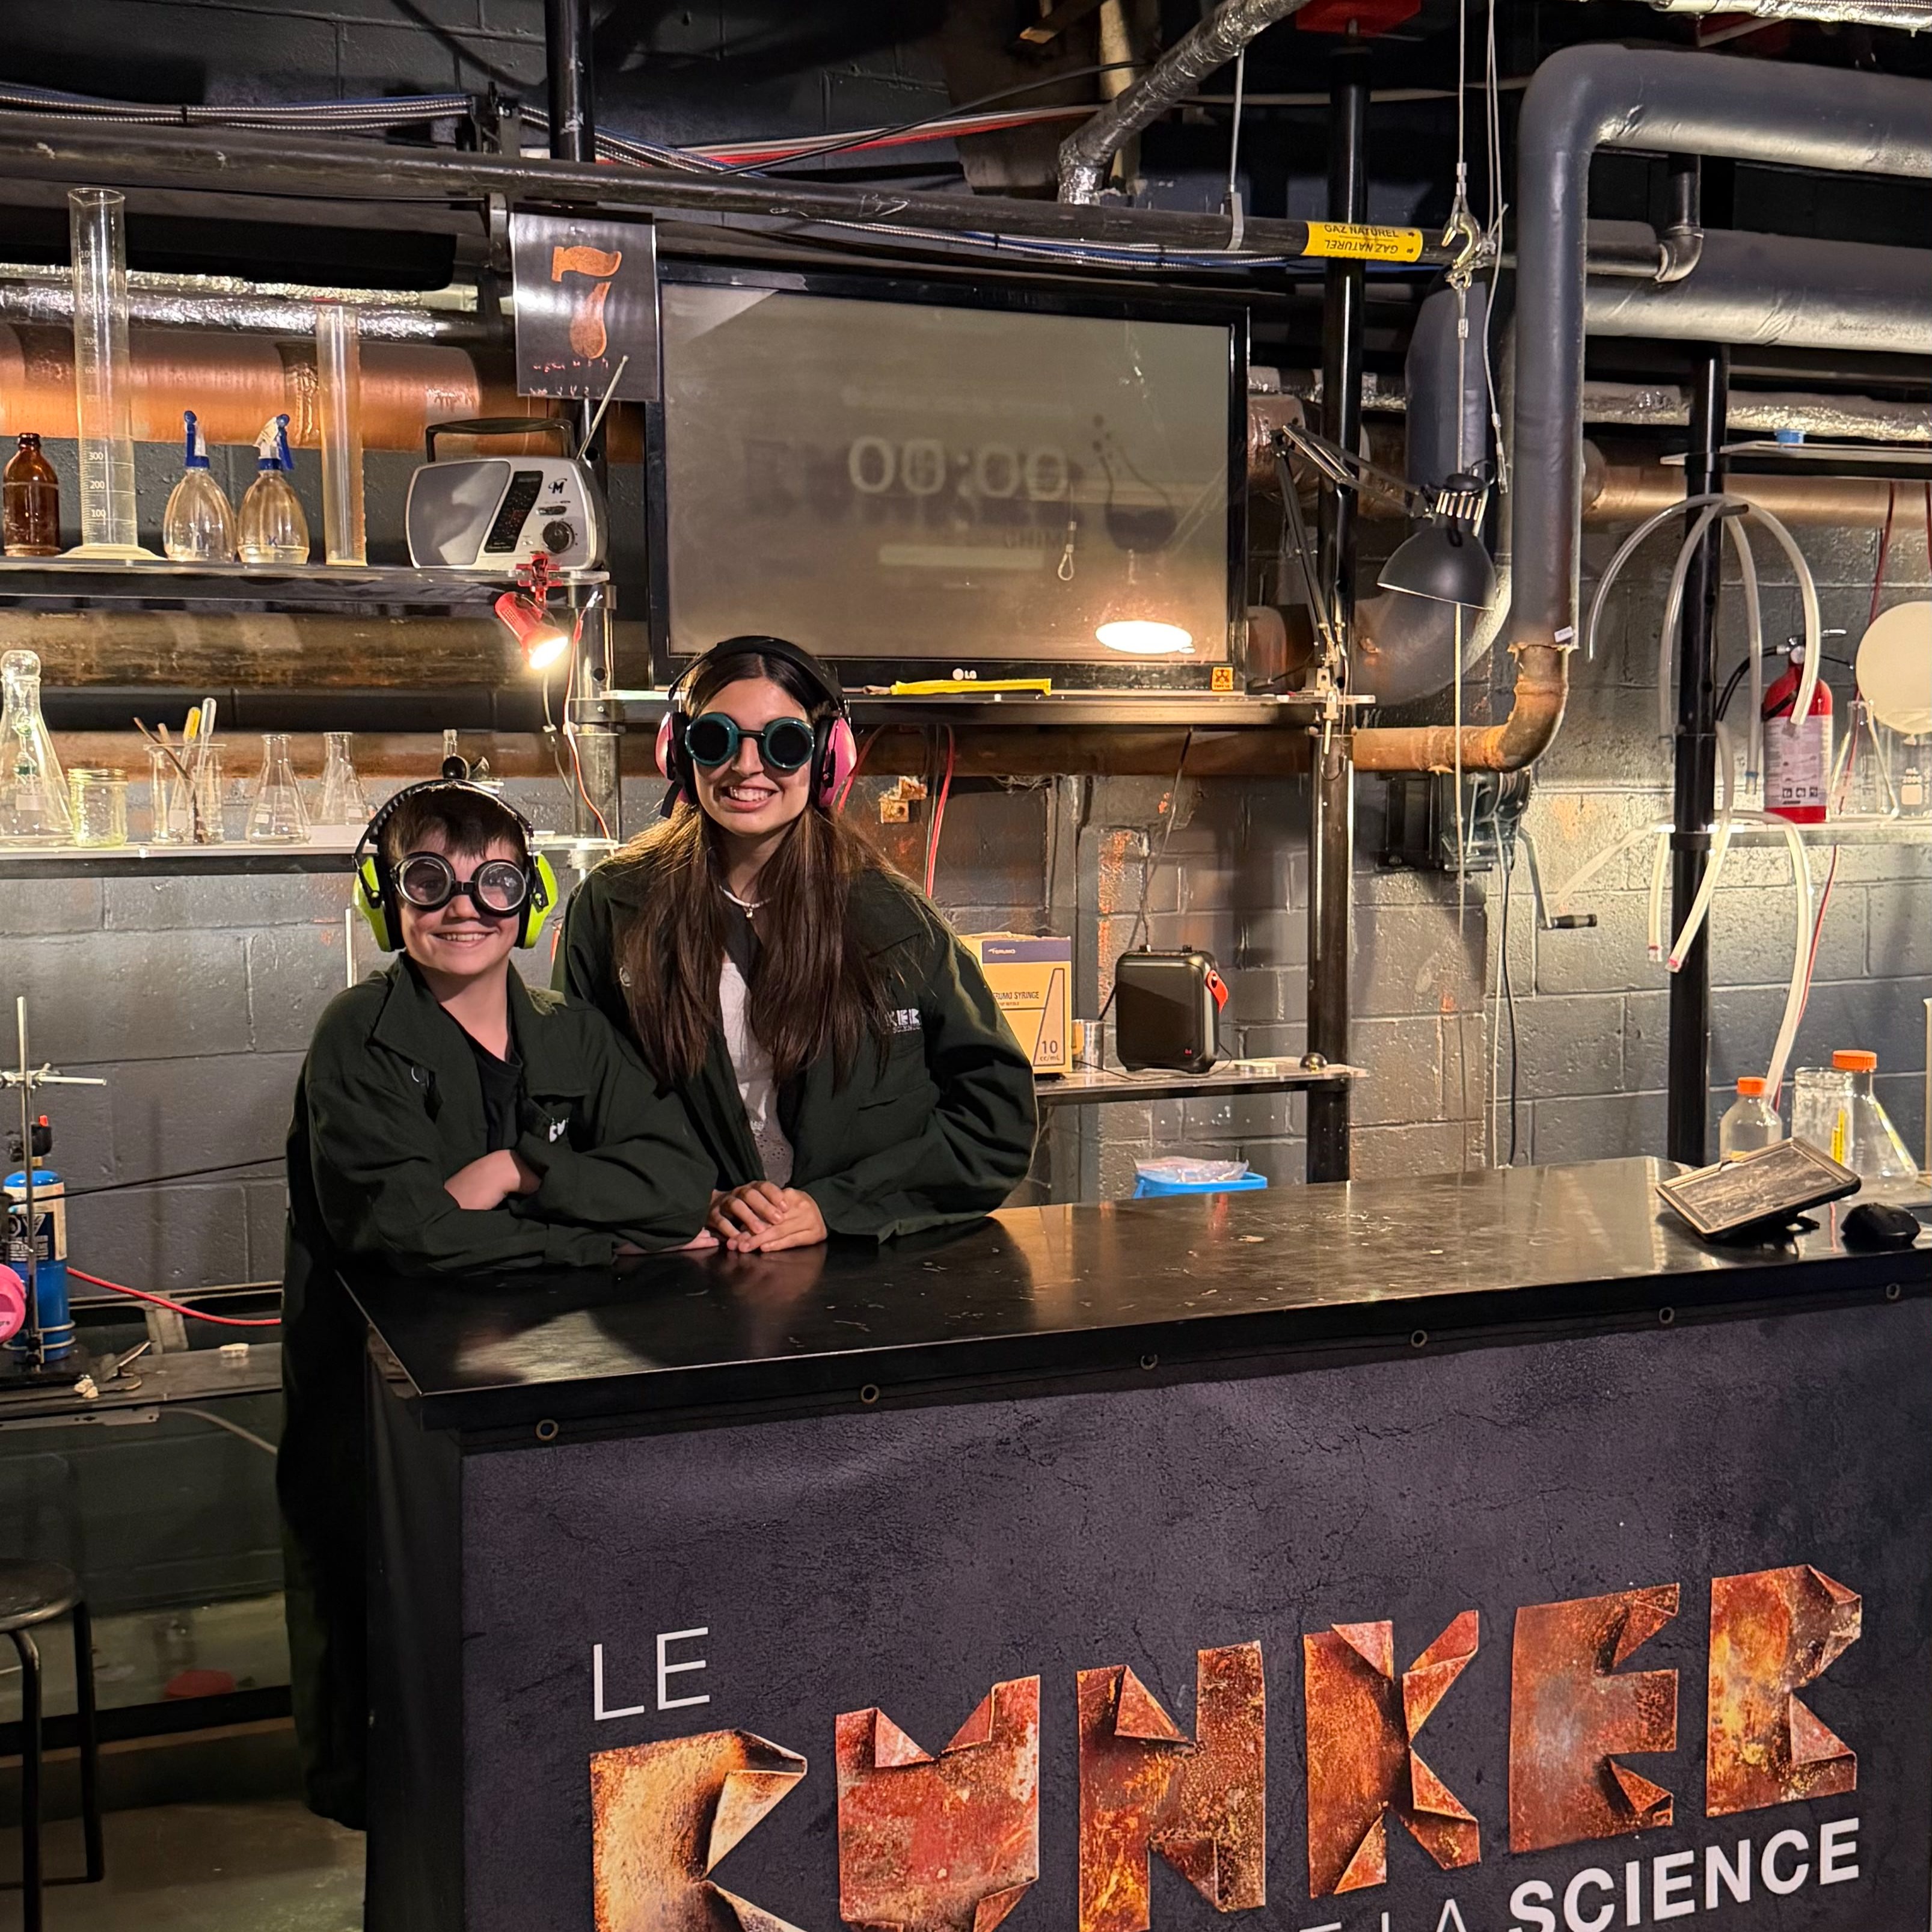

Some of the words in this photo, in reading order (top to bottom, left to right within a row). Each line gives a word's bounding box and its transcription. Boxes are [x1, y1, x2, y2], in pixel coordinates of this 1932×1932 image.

[1324, 225, 1347, 234] GAZ
[1350, 225, 1399, 238] NATUREL
[1325, 240, 1373, 252] NATUREL
[1375, 245, 1398, 254] GAZ
[551, 245, 622, 360] 7
[88, 452, 103, 461] 300
[90, 481, 105, 489] 200
[91, 509, 106, 518] 100
[1041, 1040, 1058, 1054] 10
[593, 1627, 710, 1721] LE
[589, 1565, 1862, 1932] BUNKER
[1508, 1817, 1859, 1932] SCIENCE
